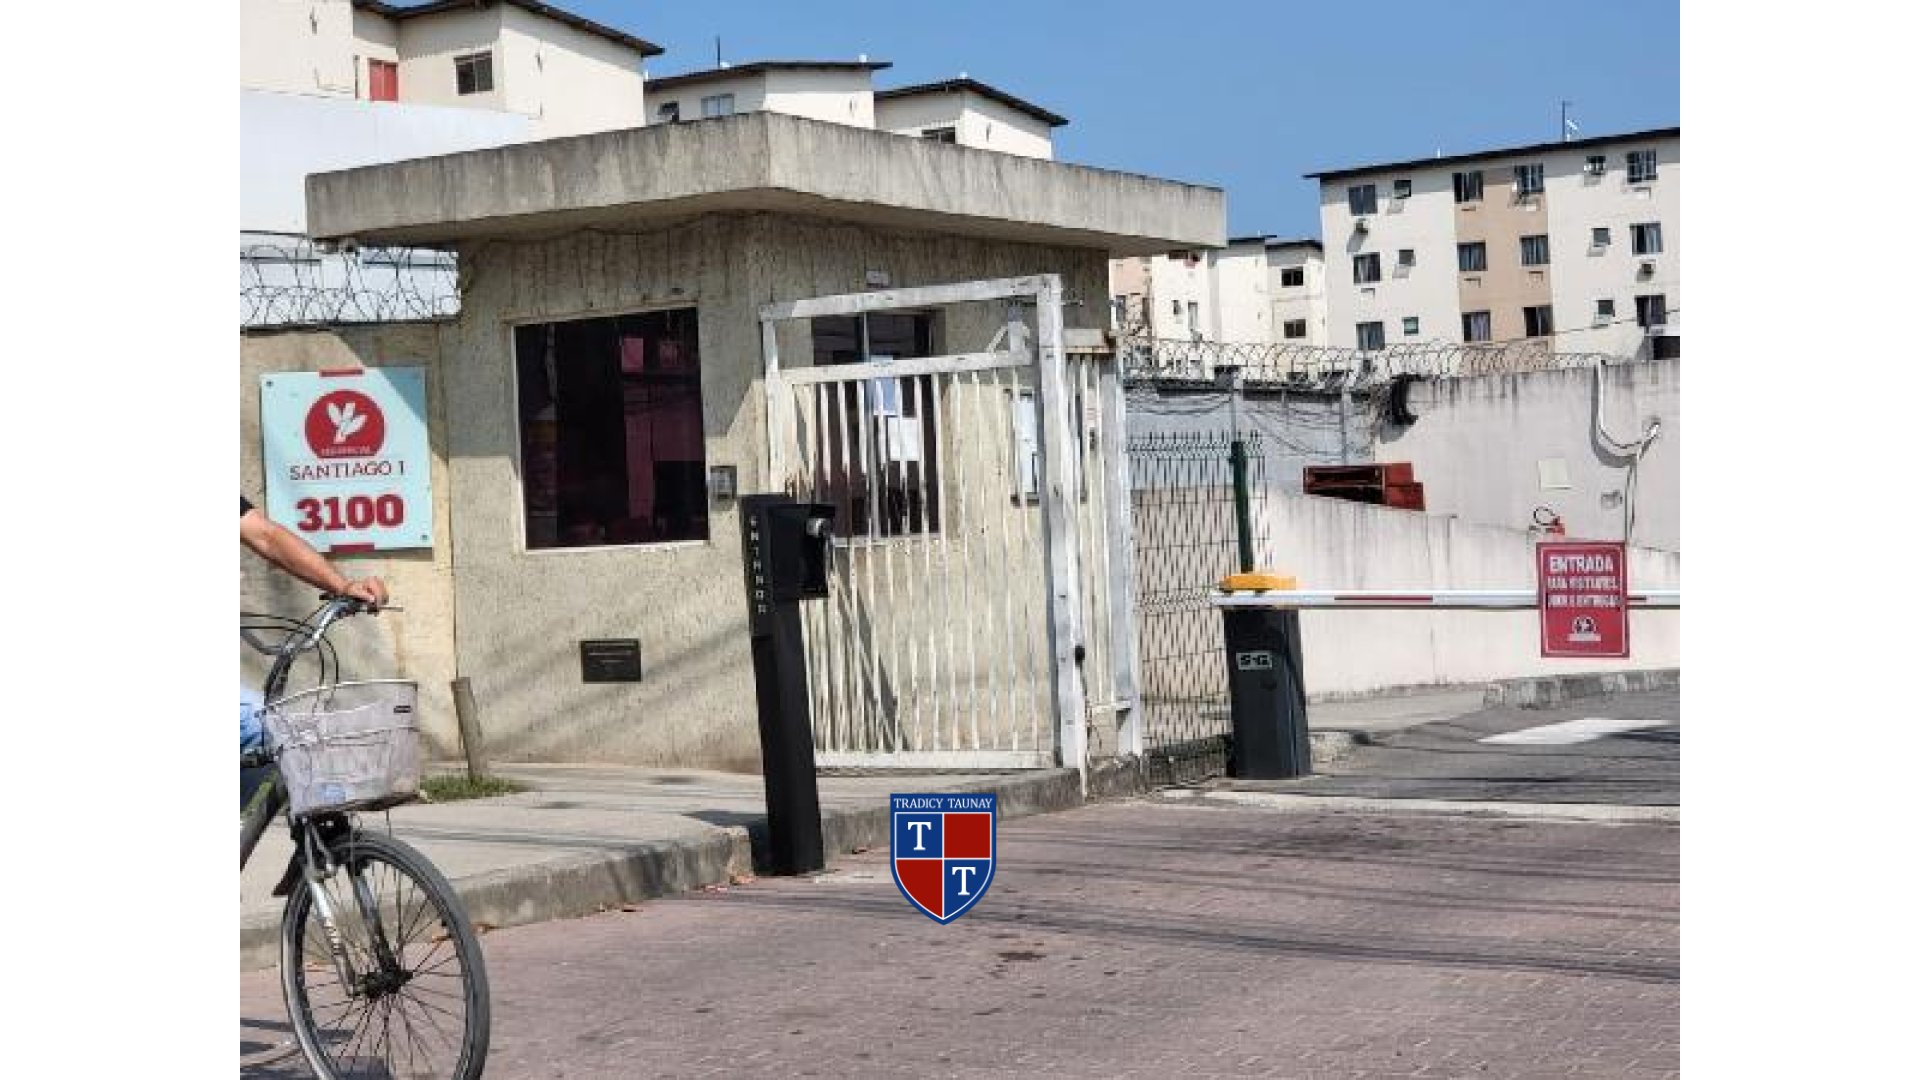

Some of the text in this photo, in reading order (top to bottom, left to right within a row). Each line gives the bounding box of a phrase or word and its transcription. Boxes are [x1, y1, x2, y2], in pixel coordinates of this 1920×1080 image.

[290, 460, 392, 480] SANTIAGO
[297, 494, 404, 532] 3100
[1549, 554, 1614, 573] ENTRADA
